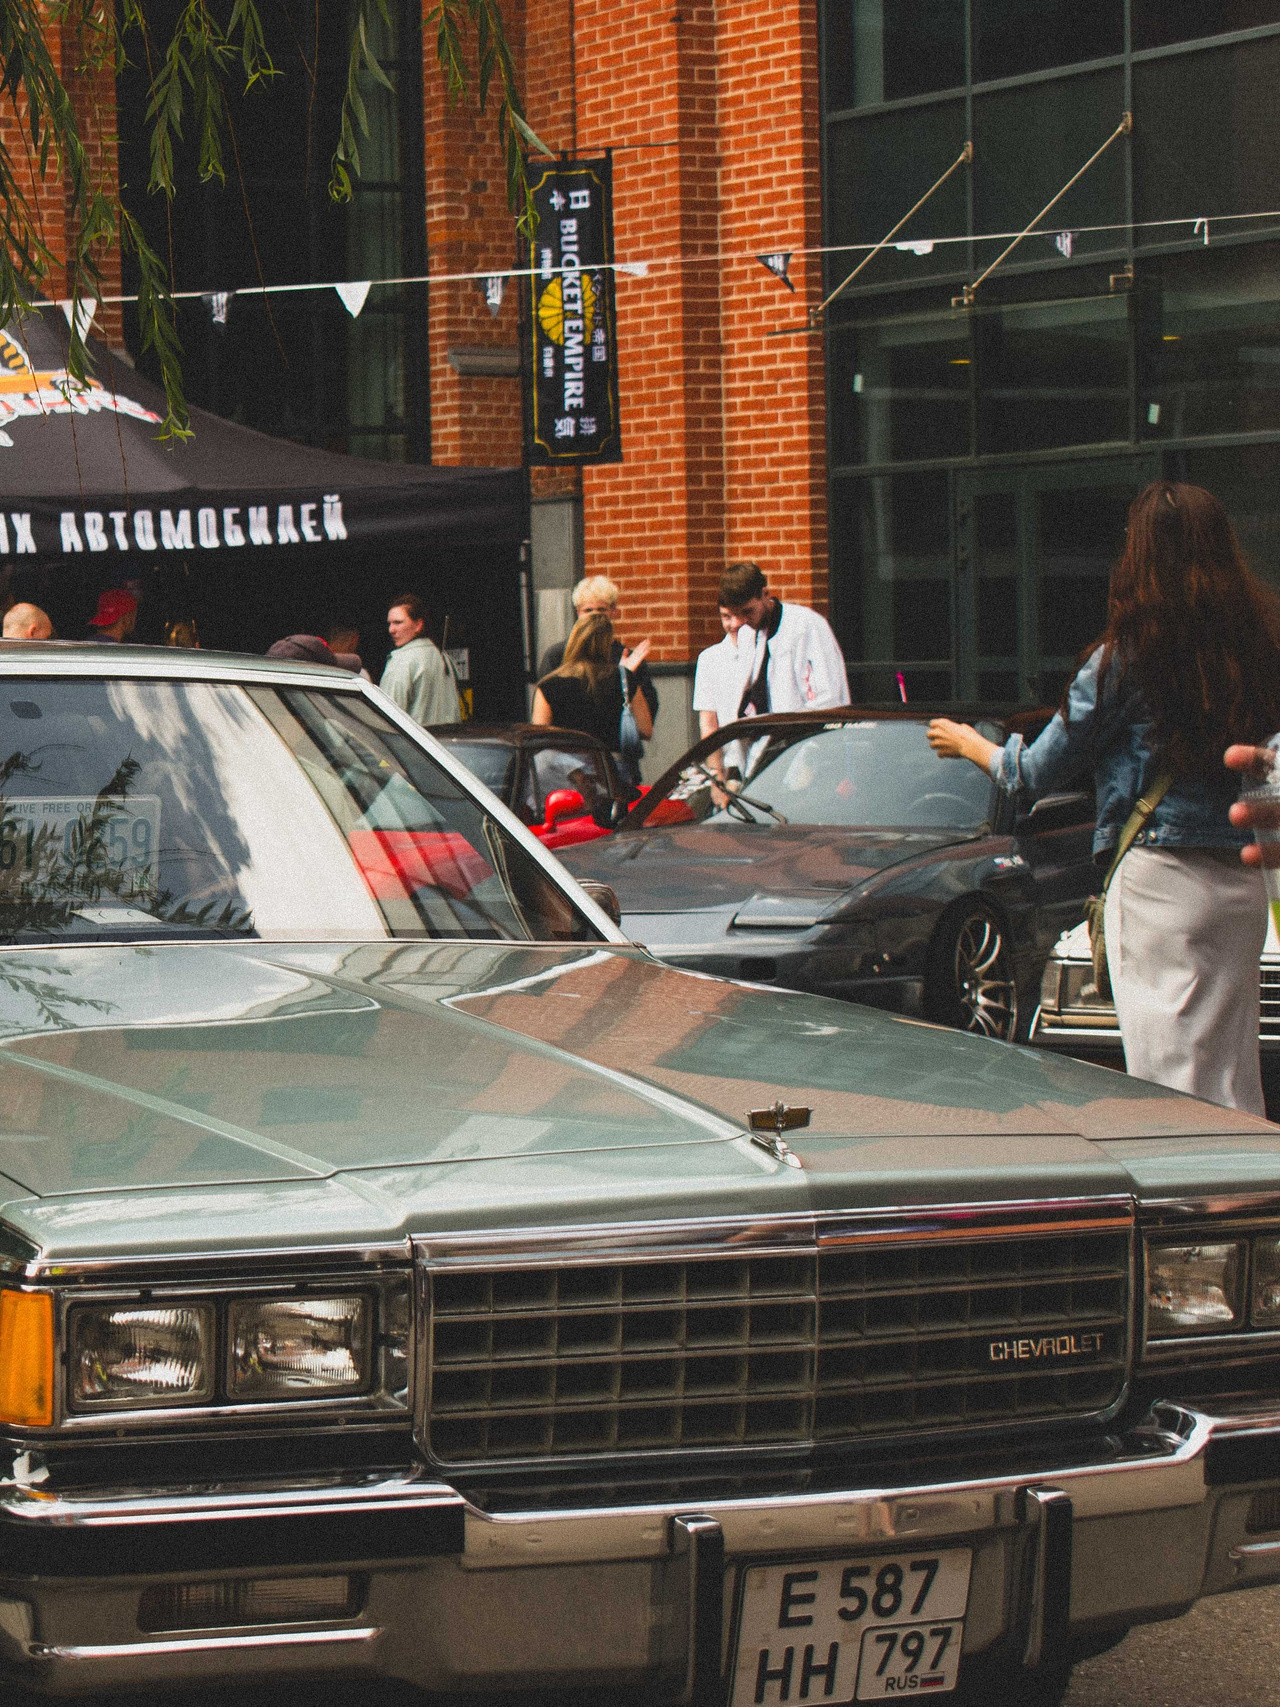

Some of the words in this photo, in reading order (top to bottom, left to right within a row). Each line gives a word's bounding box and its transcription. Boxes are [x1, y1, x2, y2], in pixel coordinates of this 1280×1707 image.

[560, 218, 583, 315] BUCKET
[563, 318, 585, 412] EMPIRE
[59, 494, 348, 552] АВТОМОБИЛЕЙ
[12, 803, 36, 814] LIVE
[42, 803, 71, 814] FREE
[76, 803, 92, 813] OR
[990, 1332, 1104, 1360] CHEVROLET
[837, 1558, 940, 1622] 587
[875, 1626, 952, 1676] 797
[884, 1673, 919, 1692] RUS
